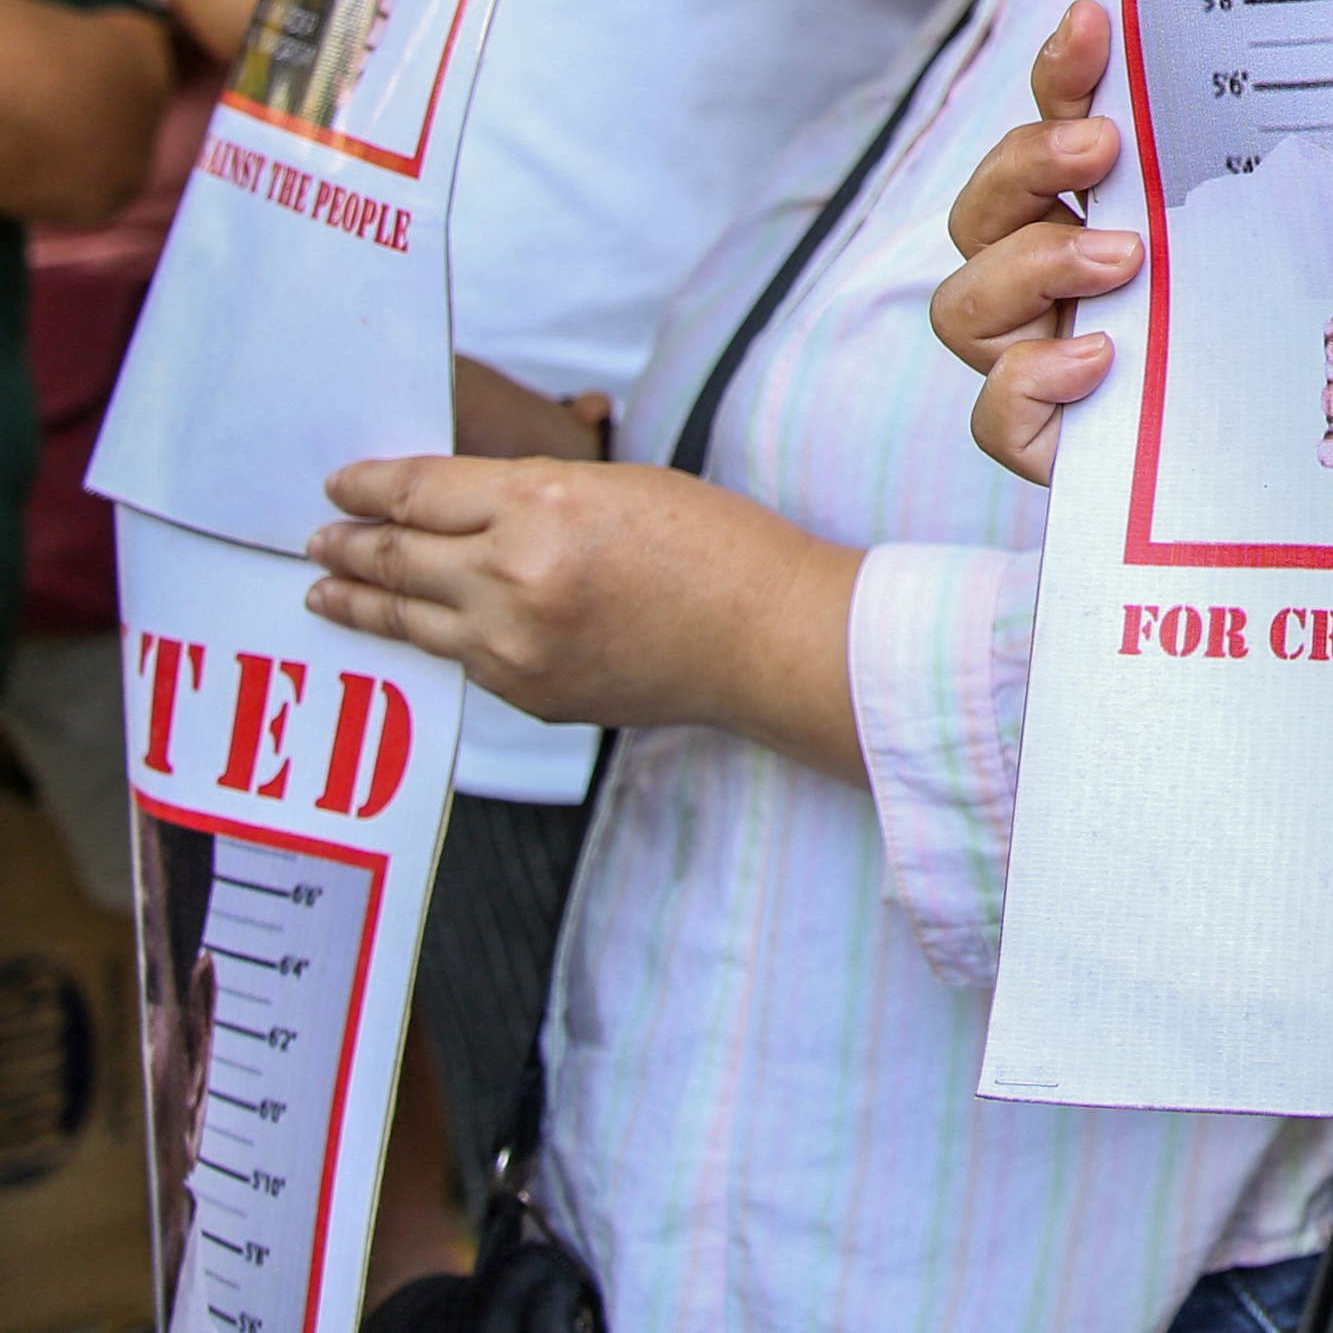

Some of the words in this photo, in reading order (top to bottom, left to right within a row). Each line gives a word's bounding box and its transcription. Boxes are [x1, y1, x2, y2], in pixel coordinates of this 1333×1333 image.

[266, 163, 312, 213] THE
[312, 179, 411, 252] PEOPLE
[1120, 605, 1248, 659] FOR
